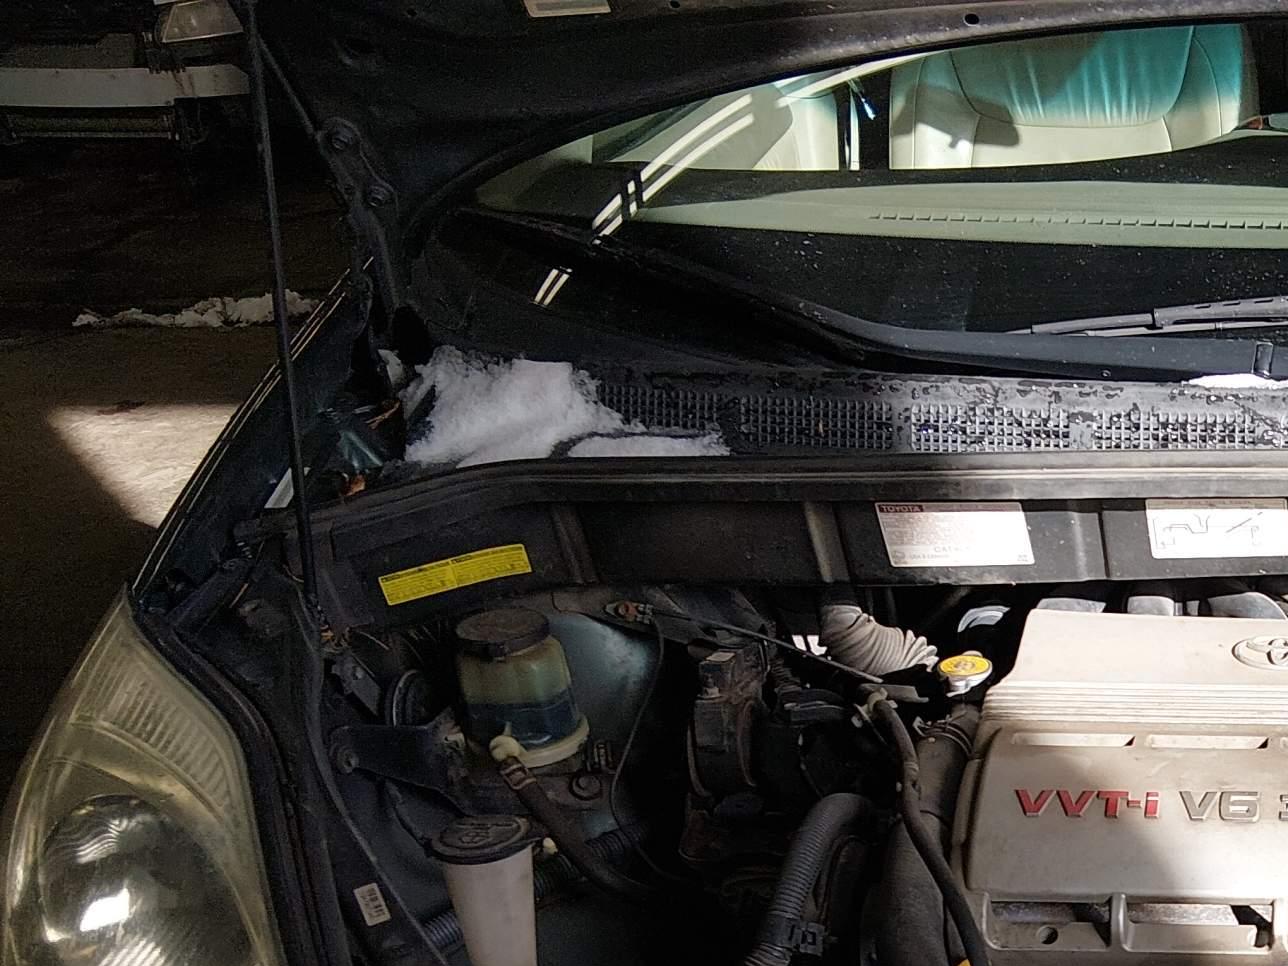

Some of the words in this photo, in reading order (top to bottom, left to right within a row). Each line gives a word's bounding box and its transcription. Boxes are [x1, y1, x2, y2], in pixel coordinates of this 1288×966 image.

[880, 504, 921, 513] TOYOTA
[1015, 790, 1160, 819] VVT-i
[1179, 790, 1261, 822] V6
